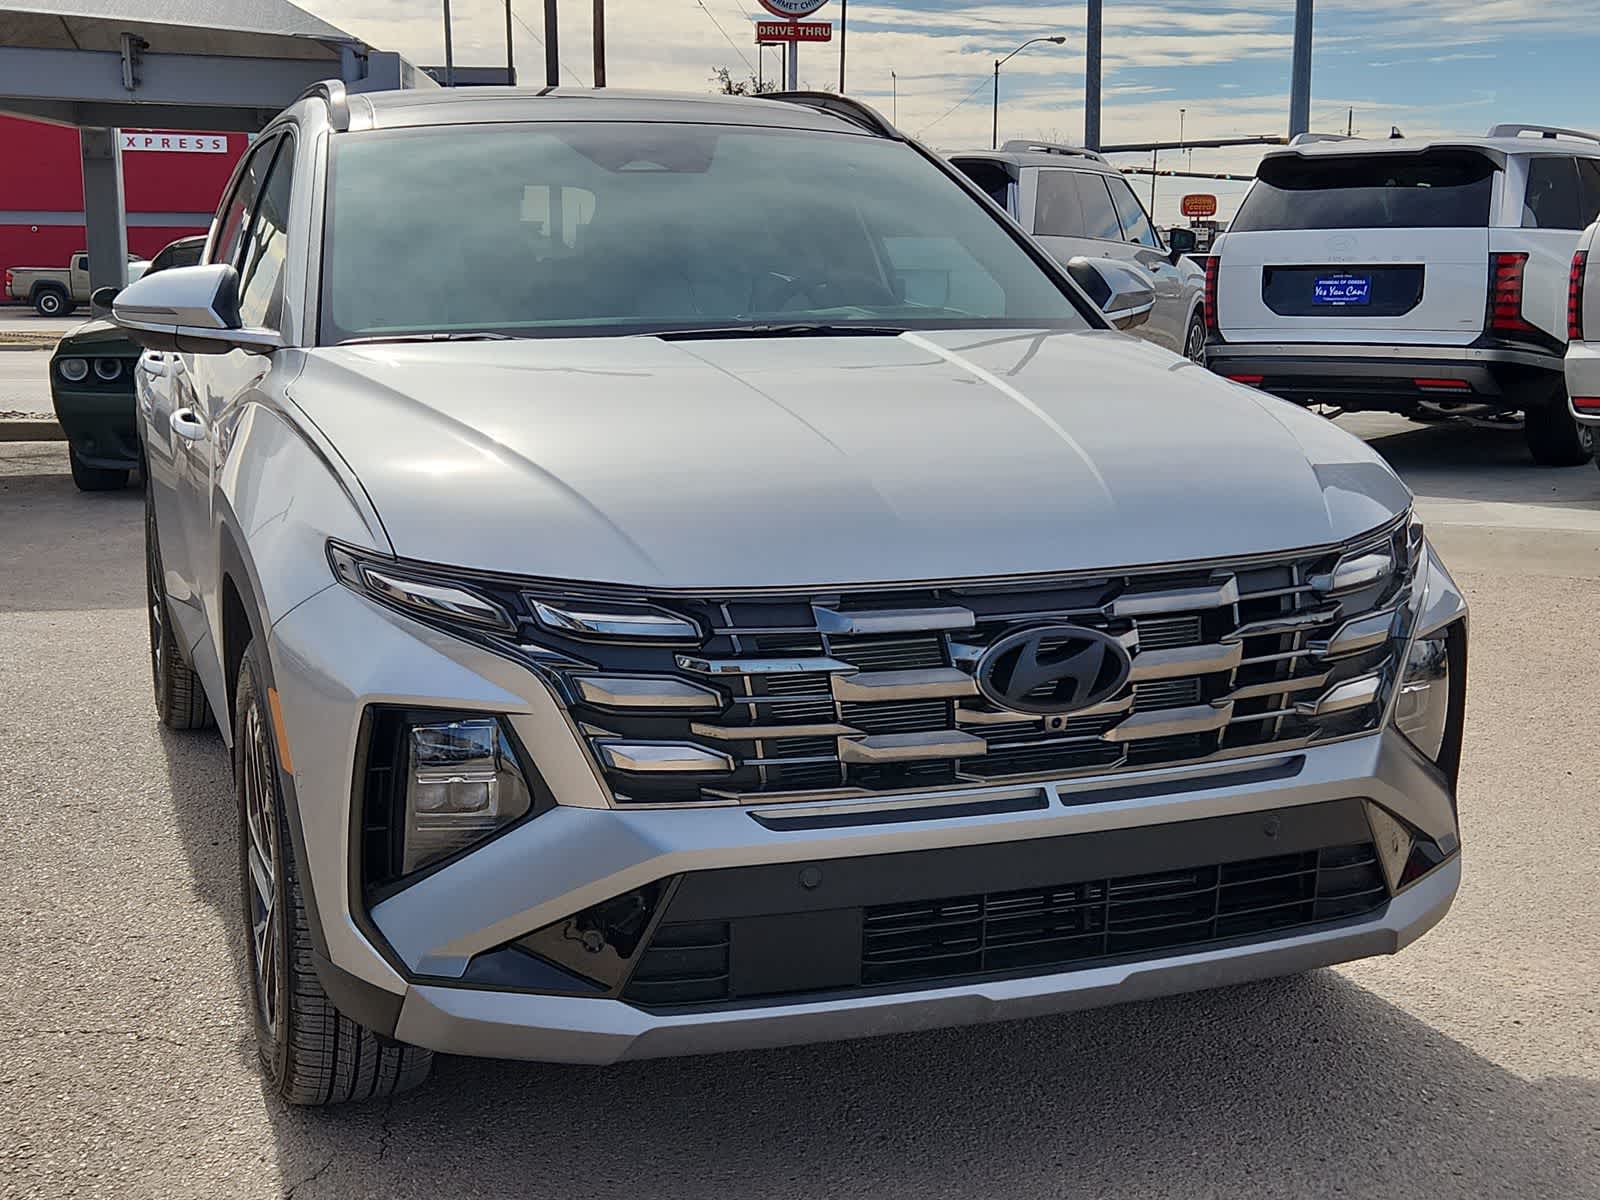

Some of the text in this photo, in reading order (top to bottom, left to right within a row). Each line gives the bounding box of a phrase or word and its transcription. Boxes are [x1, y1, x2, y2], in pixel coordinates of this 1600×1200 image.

[759, 26, 831, 36] DRIVE THRU
[126, 136, 221, 150] XPRESS
[1315, 285, 1368, 296] Yes You Can!
